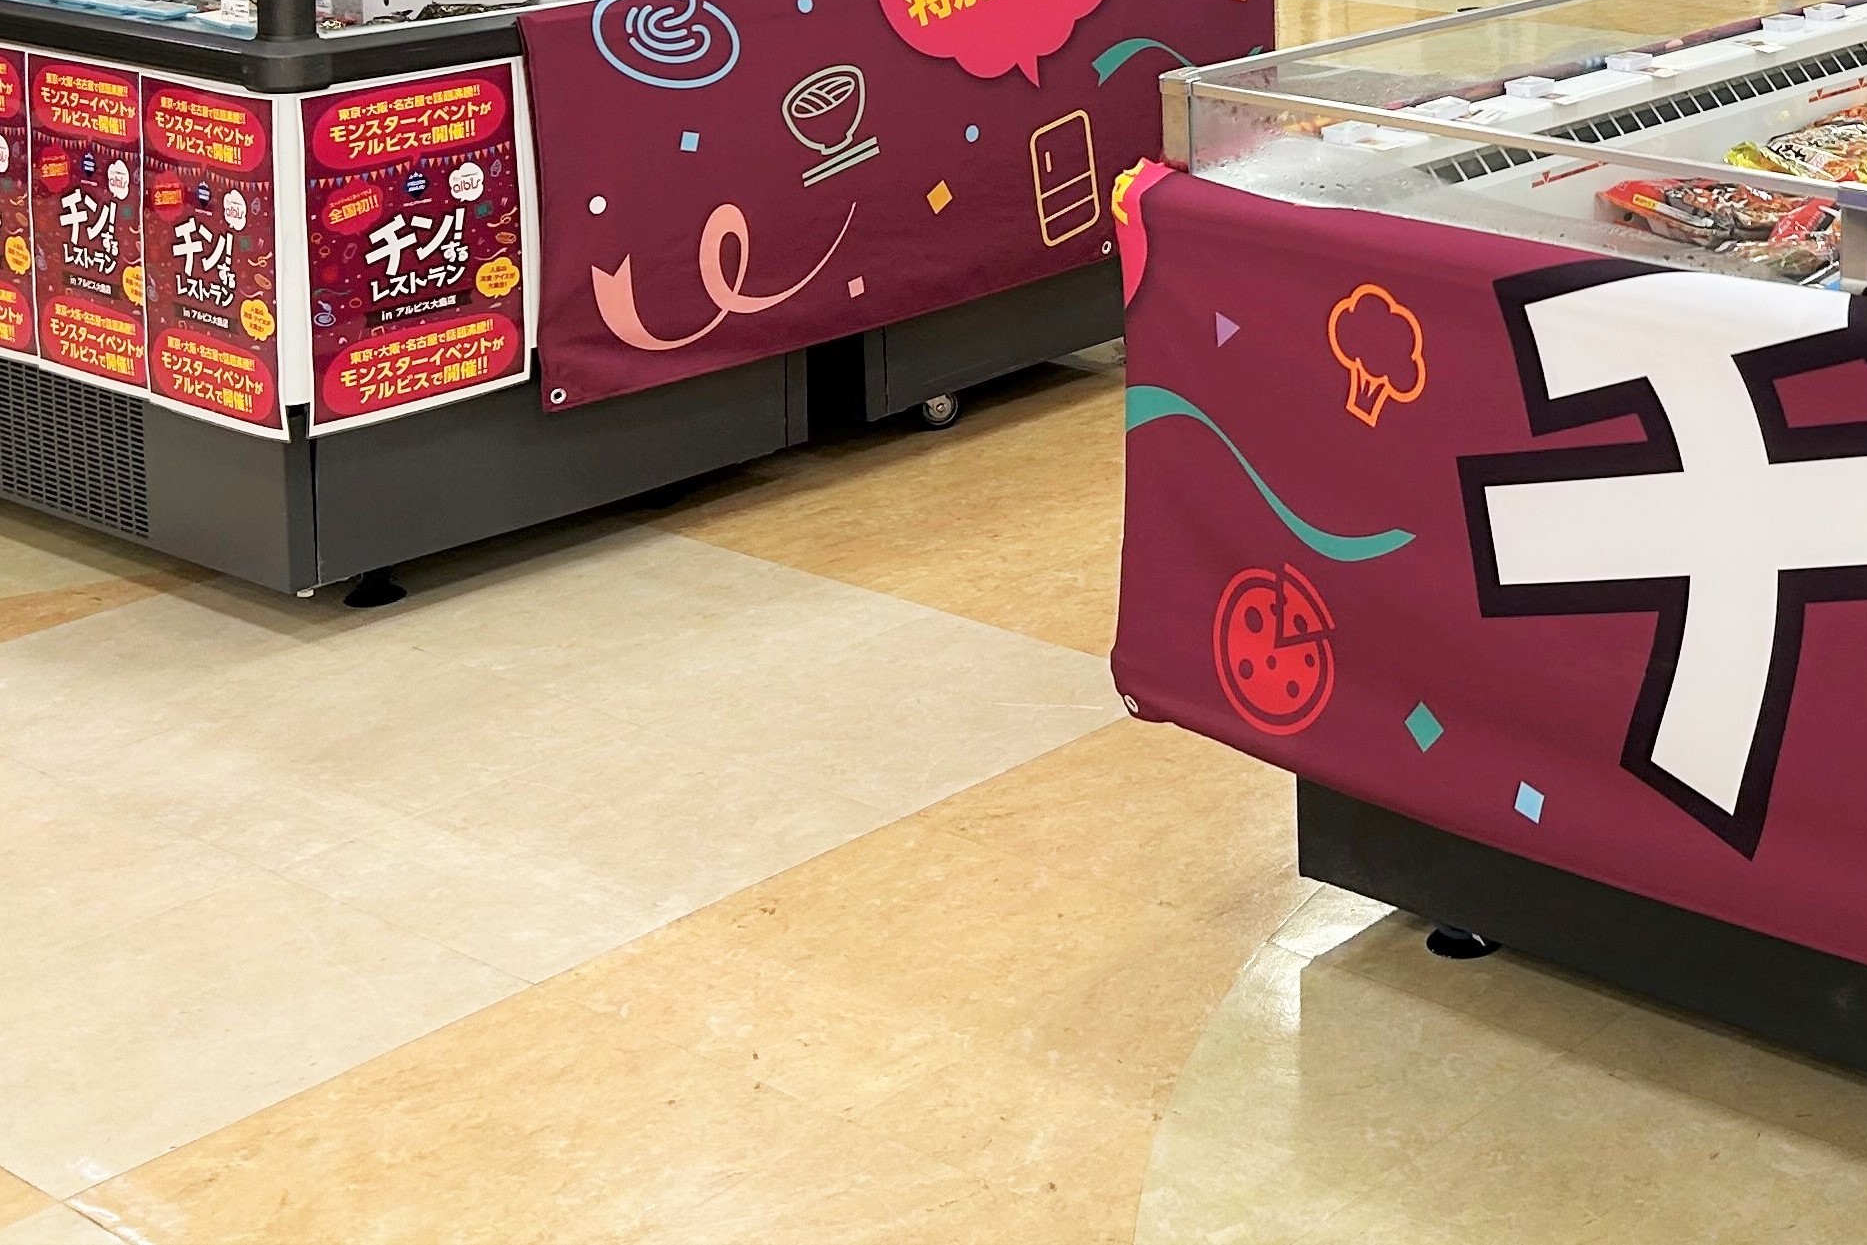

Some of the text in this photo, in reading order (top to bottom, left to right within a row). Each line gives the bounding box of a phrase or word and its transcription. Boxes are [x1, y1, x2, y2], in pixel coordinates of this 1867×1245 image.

[41, 86, 136, 119] モンスターイベントが
[329, 101, 492, 143] モンスターイベントが
[155, 110, 254, 147] モンスターイベントが
[349, 119, 476, 159] アルビスで開催!!
[165, 132, 242, 166] アルビスで開催!!
[60, 188, 116, 245] チン!
[329, 196, 379, 225] 全国初!!
[63, 243, 117, 275] レストラン
[172, 217, 234, 277] チン!
[365, 208, 465, 275] チン!
[441, 241, 468, 262] する
[176, 275, 234, 307] レストラン
[371, 263, 465, 302] レストラン
[381, 295, 457, 322] in アルビス大島店
[50, 318, 144, 359] モンスターイベントが
[161, 350, 264, 396] モンスターイベントが
[340, 336, 505, 388] モンスターイベントが
[359, 357, 489, 404] アルビスで開催!!
[172, 373, 253, 414] アルビスで開催!!
